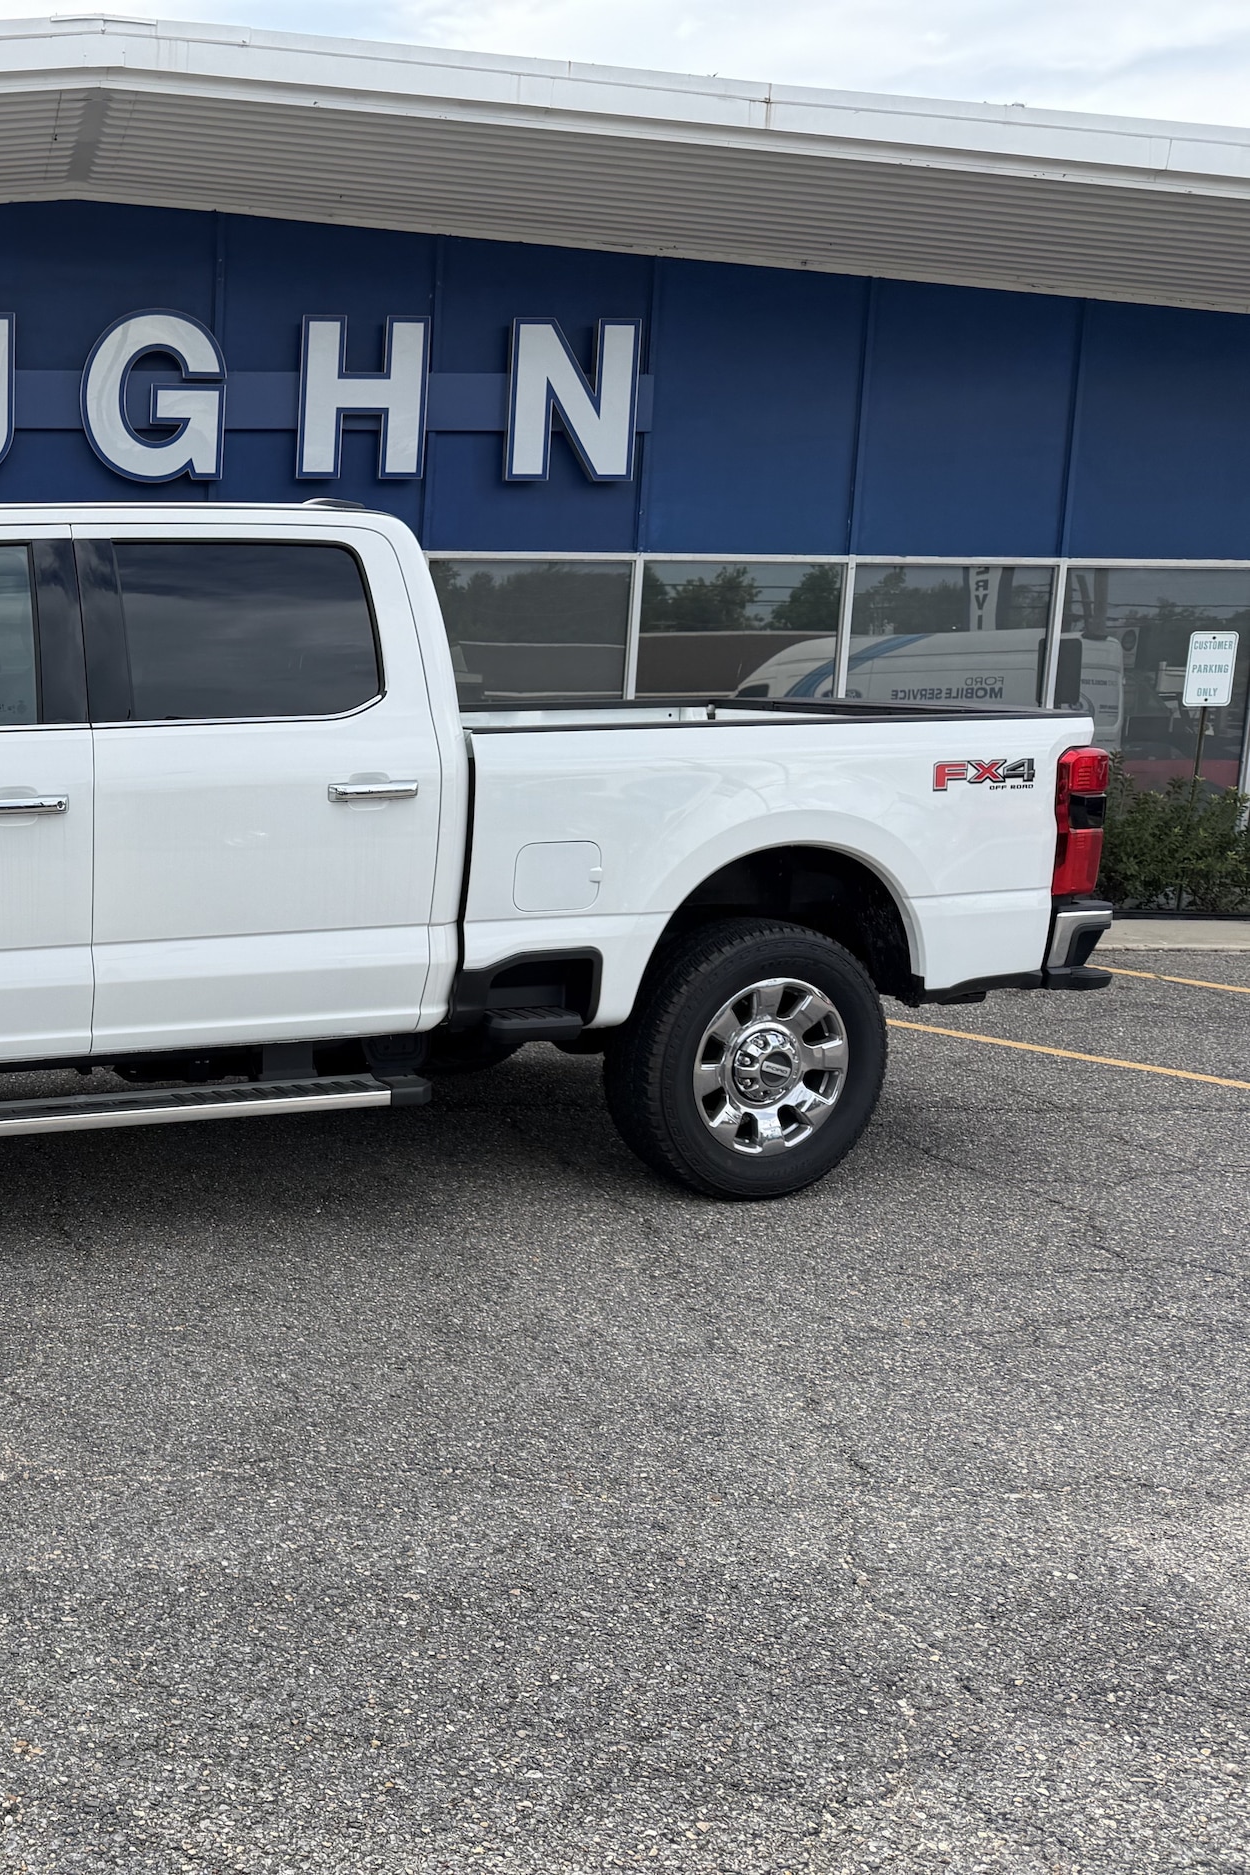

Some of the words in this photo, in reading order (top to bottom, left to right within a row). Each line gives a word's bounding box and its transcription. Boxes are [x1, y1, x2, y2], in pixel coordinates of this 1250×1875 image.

[1193, 640, 1234, 650] CUSTOMER
[1191, 664, 1229, 674] PARKING
[1196, 687, 1219, 697] ONLY
[932, 757, 1036, 792] FX4
[765, 1064, 788, 1075] FORD
